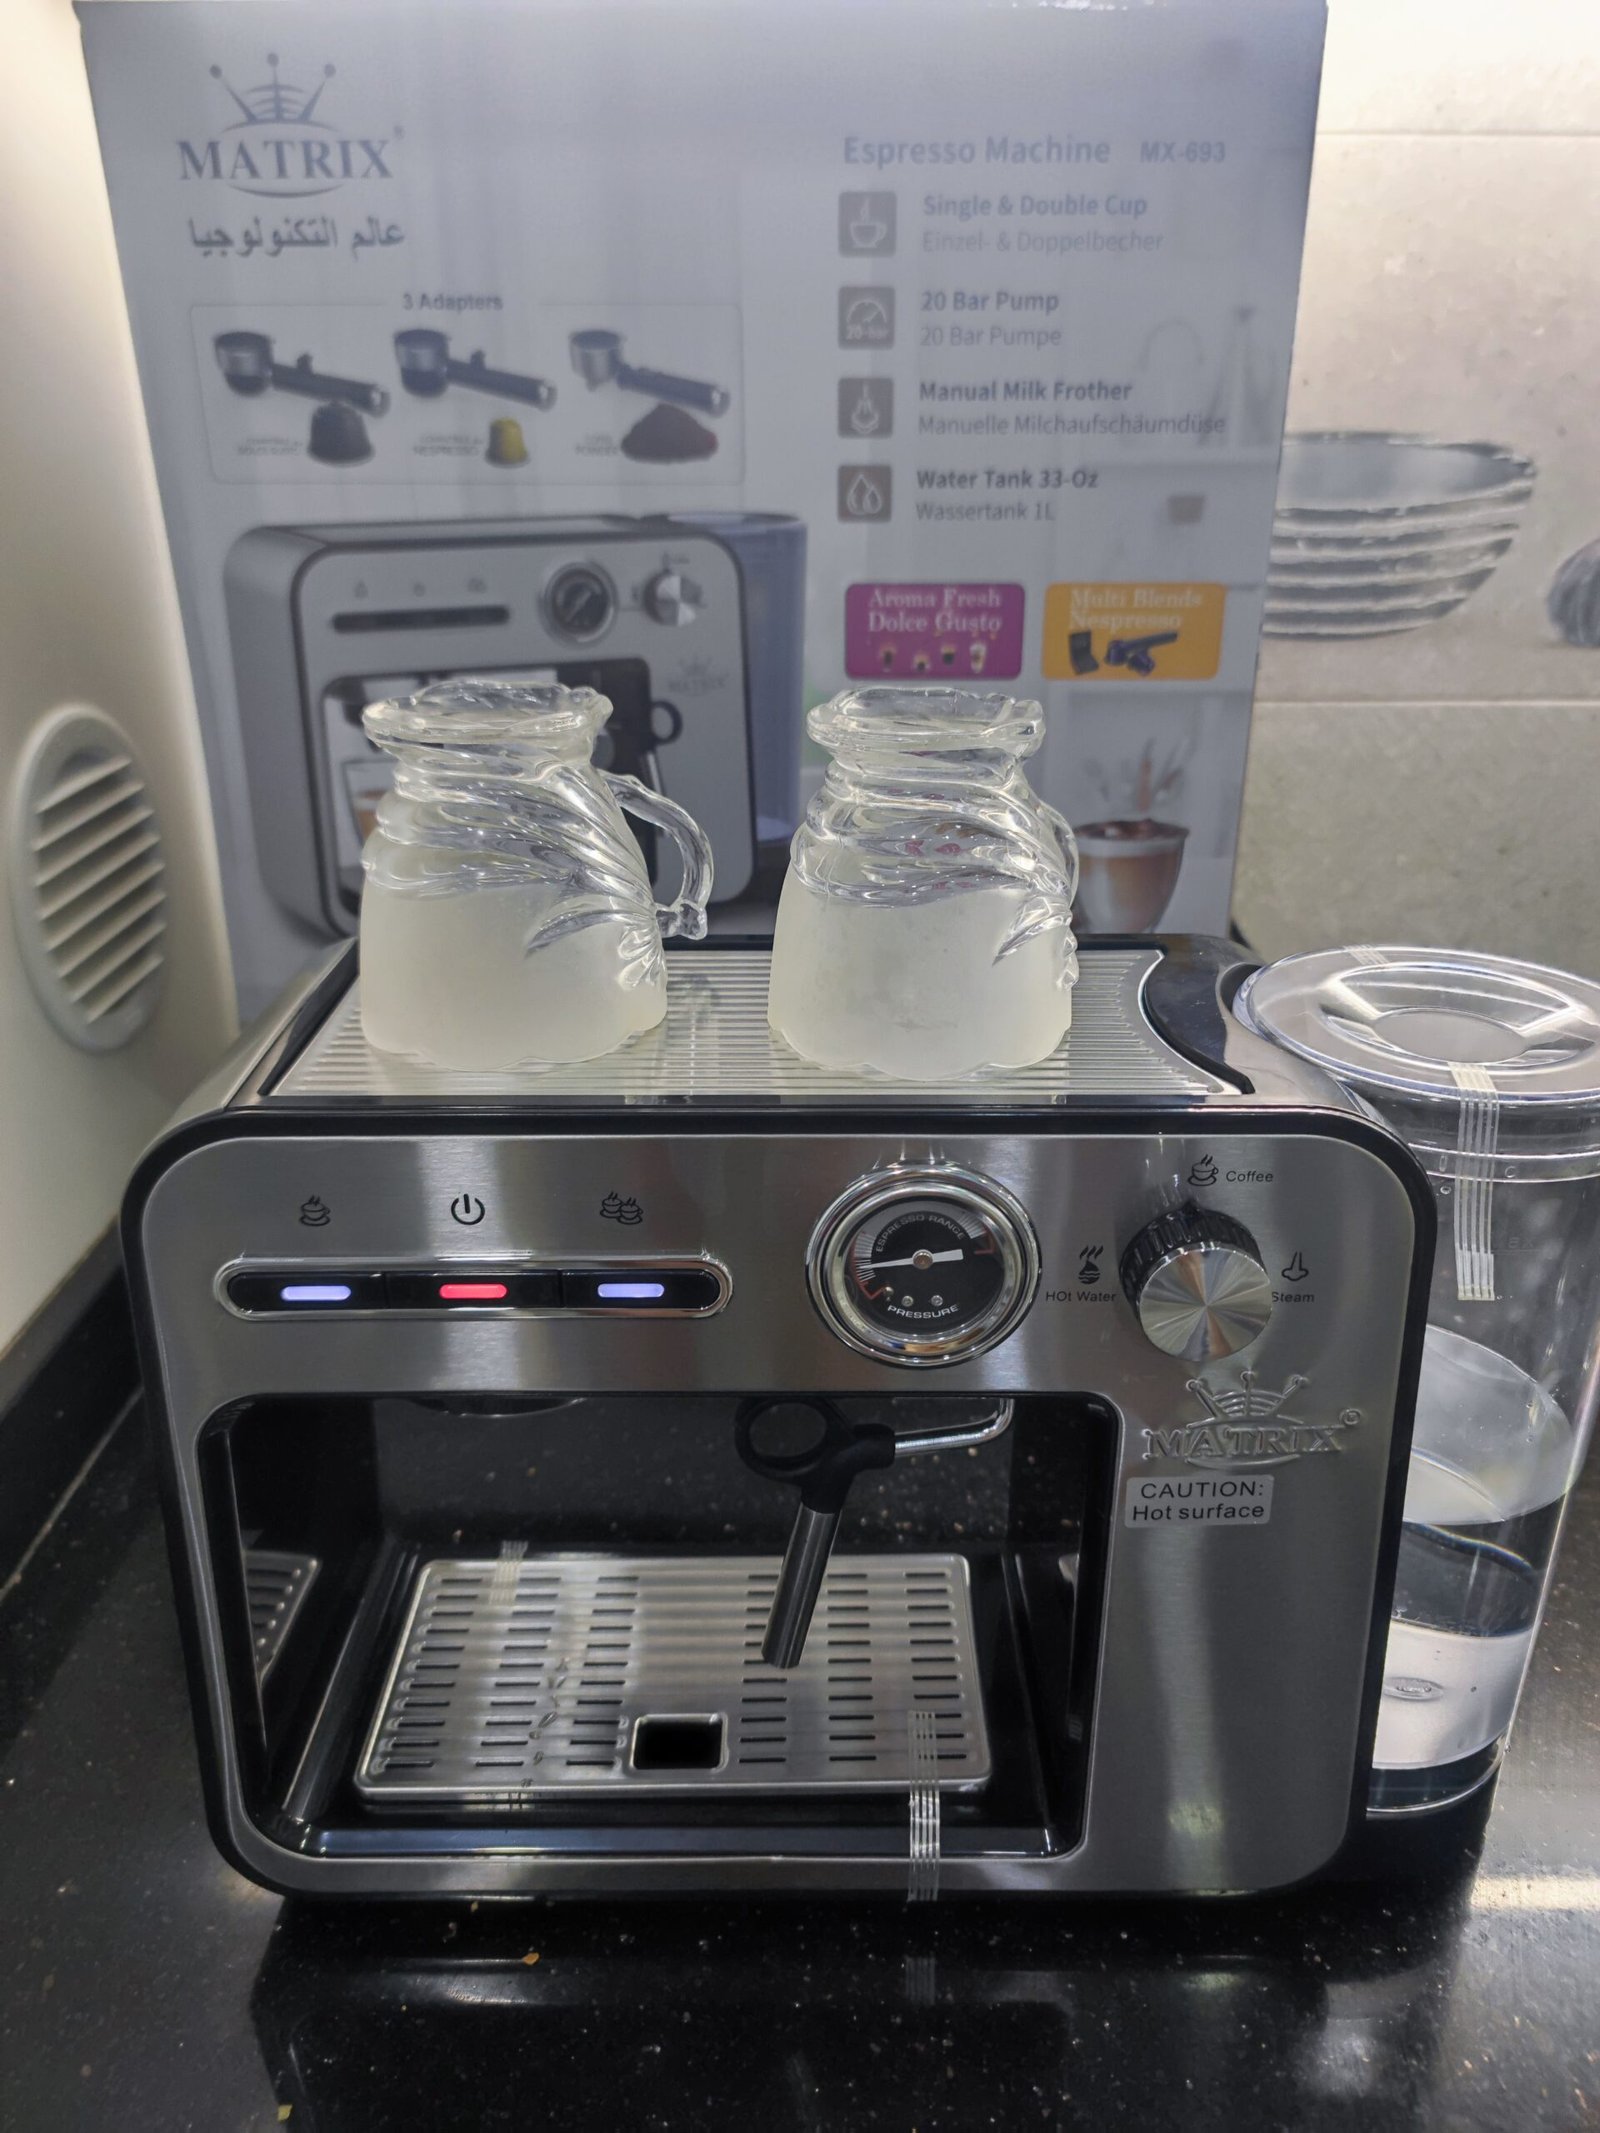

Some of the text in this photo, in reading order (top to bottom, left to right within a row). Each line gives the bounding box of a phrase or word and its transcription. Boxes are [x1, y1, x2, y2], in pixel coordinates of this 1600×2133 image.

[175, 138, 394, 181] MATRIX
[843, 134, 1227, 169] Espresso Machine MX-693
[923, 195, 1149, 222] Single & Double Cup
[352, 214, 405, 262] عالم
[996, 231, 1011, 252] &
[1018, 230, 1164, 254] Doppelbecher
[403, 293, 504, 315] 3 Adapters
[920, 290, 1060, 316] 20 Bar Pump
[920, 326, 1062, 351] 20 Bar Pumpe
[919, 381, 1133, 401] Manual Milk Frother
[918, 414, 1226, 435] Manuelle Milchaufschäumdüse
[916, 469, 1099, 489] Water Tank 33-Oz
[916, 503, 1055, 522] Wassertank 1L
[869, 587, 1001, 608] Aroma Fresh
[868, 610, 1003, 634] Dolce Gusto
[1069, 609, 1183, 635] Nespresso
[1225, 1170, 1274, 1183] Coffee
[876, 1214, 965, 1253] ESPRESSO RANGE
[1076, 1290, 1117, 1303] Water
[1271, 1290, 1315, 1303] Steam
[887, 1304, 959, 1319] PRESSURE
[1142, 1426, 1344, 1459] MATRIX
[1140, 1481, 1264, 1499] CAUTION:
[1132, 1503, 1265, 1521] Hot surface
